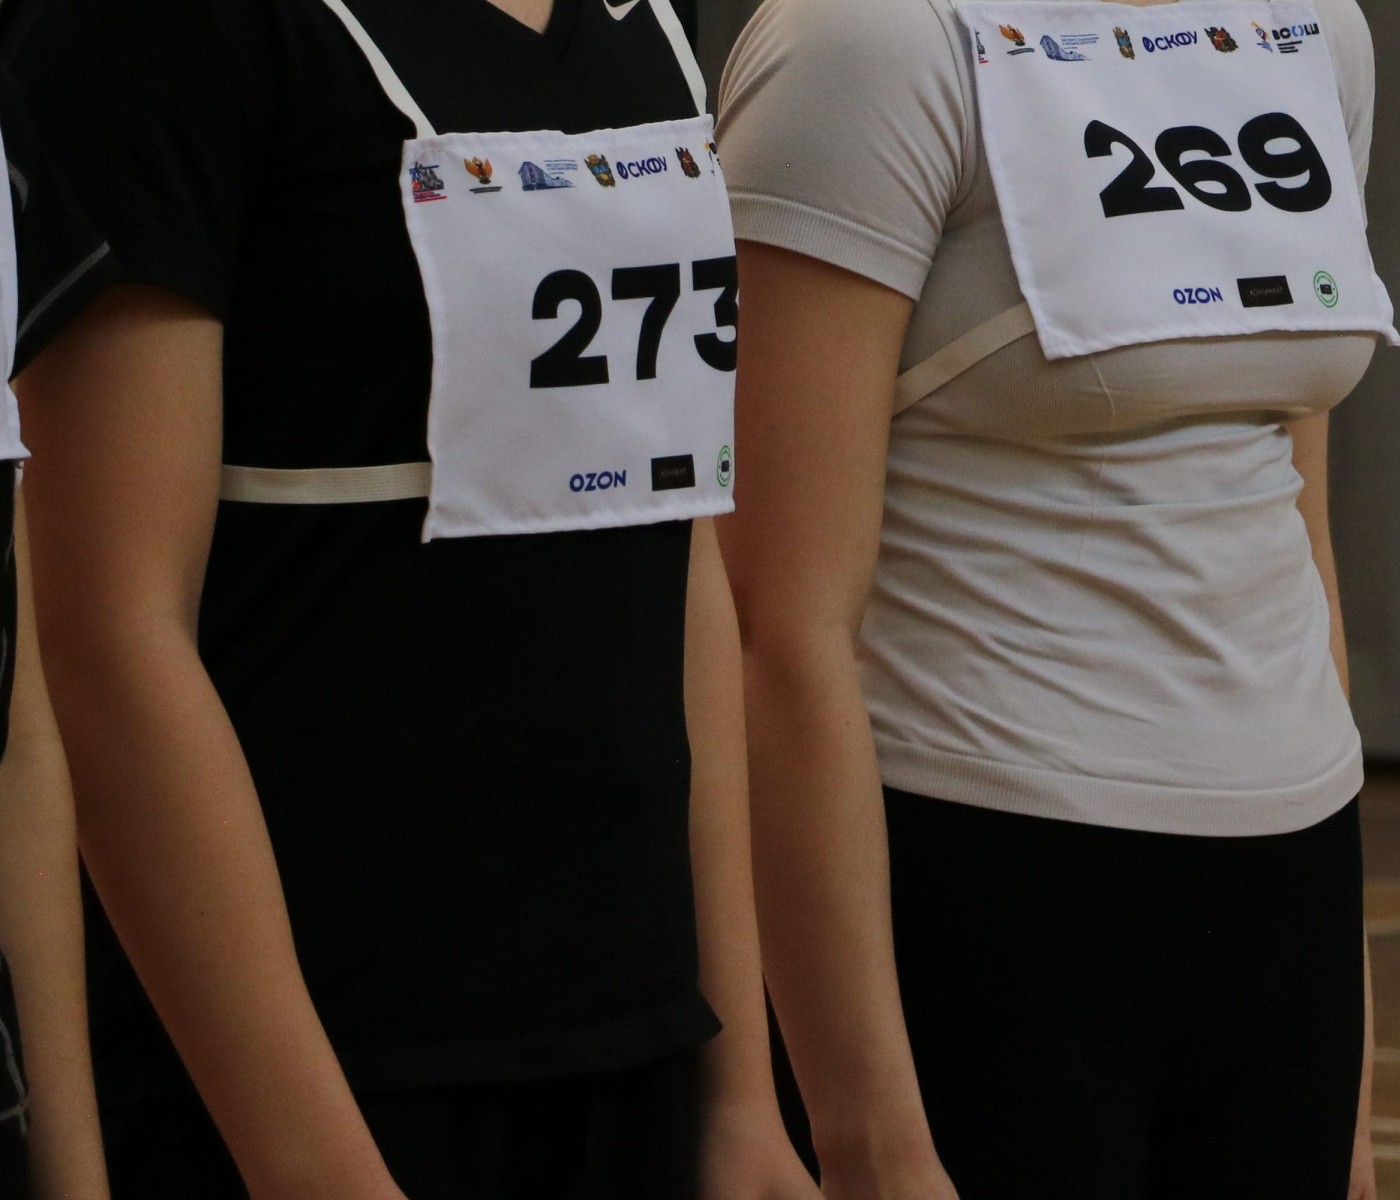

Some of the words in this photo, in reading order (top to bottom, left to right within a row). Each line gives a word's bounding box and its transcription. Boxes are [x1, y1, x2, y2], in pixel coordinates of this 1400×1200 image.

[1154, 30, 1198, 51] СКФУ
[628, 156, 669, 180] СКФУ
[1083, 111, 1332, 219] 269
[1173, 287, 1224, 305] OZON
[530, 256, 739, 389] 273
[569, 469, 627, 493] OZON
